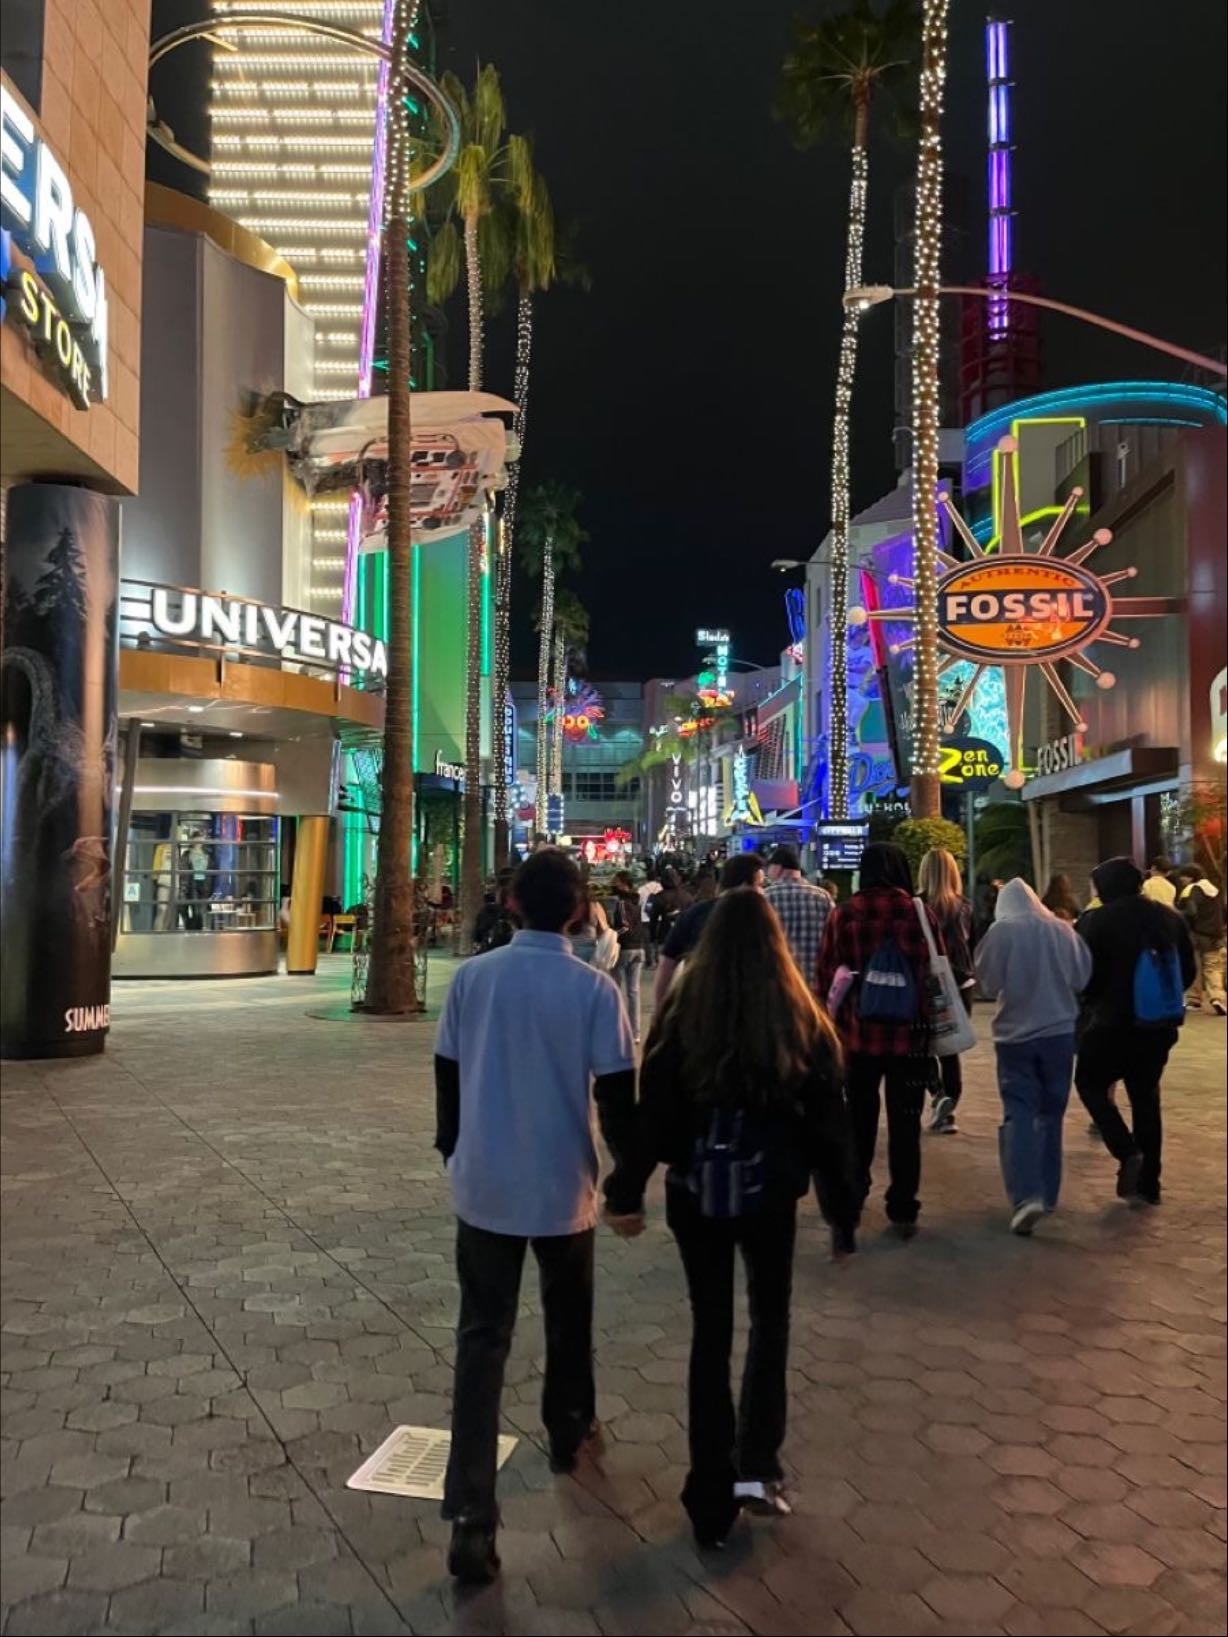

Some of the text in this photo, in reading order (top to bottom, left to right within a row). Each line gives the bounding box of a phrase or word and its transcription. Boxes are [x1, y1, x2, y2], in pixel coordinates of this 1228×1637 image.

[20, 271, 91, 407] STORE
[960, 567, 1076, 589] AUTHENTIC
[946, 593, 1094, 621] FOSSIL
[152, 589, 388, 677] UNIVERSA
[1037, 733, 1082, 776] FOSSIL
[670, 753, 683, 803] VIVO
